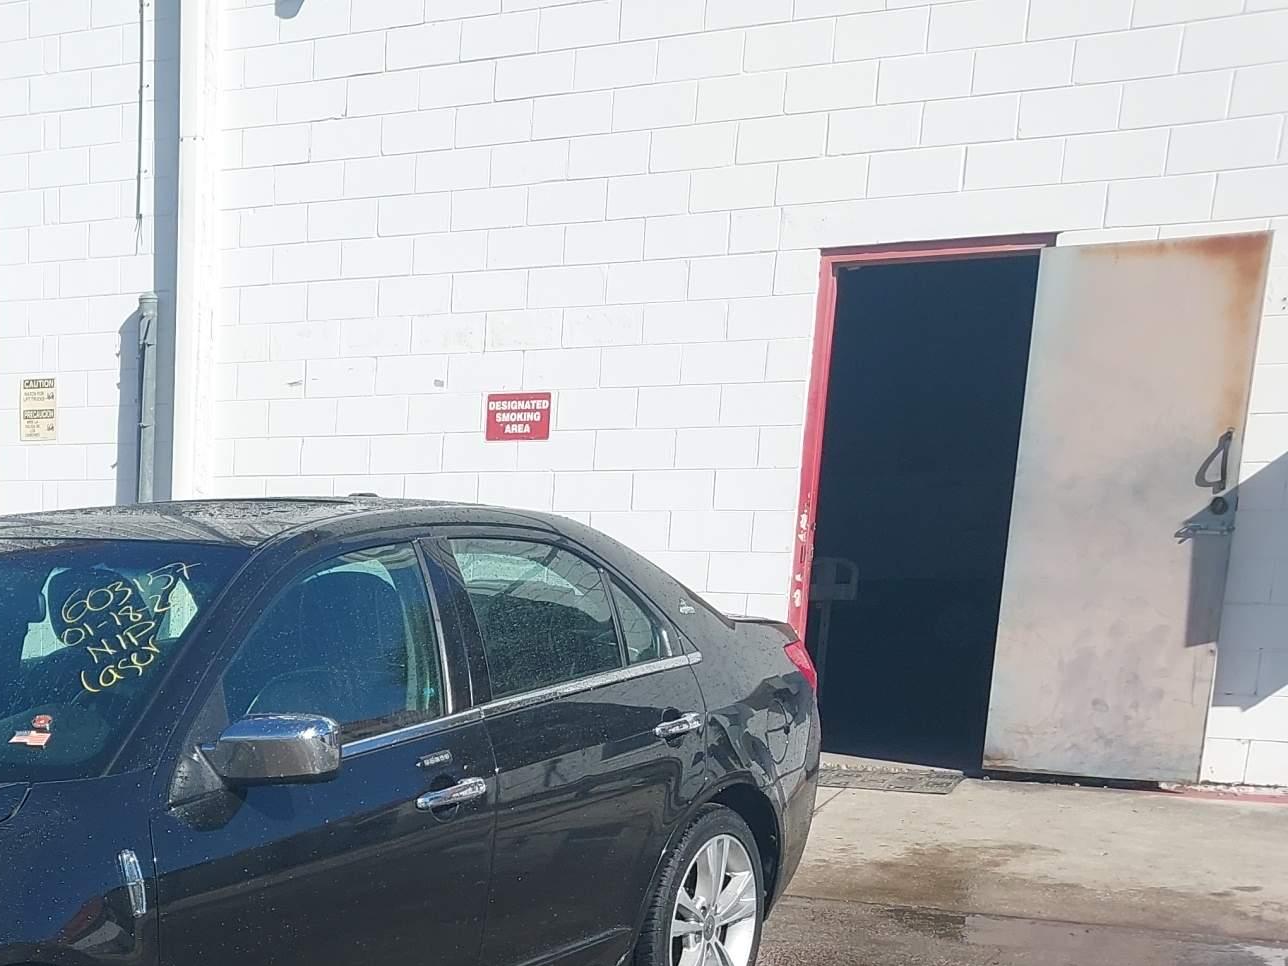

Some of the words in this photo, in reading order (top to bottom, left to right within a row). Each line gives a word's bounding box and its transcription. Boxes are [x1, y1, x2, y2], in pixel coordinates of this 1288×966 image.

[23, 379, 54, 389] CAUTION
[488, 399, 549, 411] DESIGNATED
[495, 411, 541, 422] SMOKING
[504, 423, 531, 433] AREA
